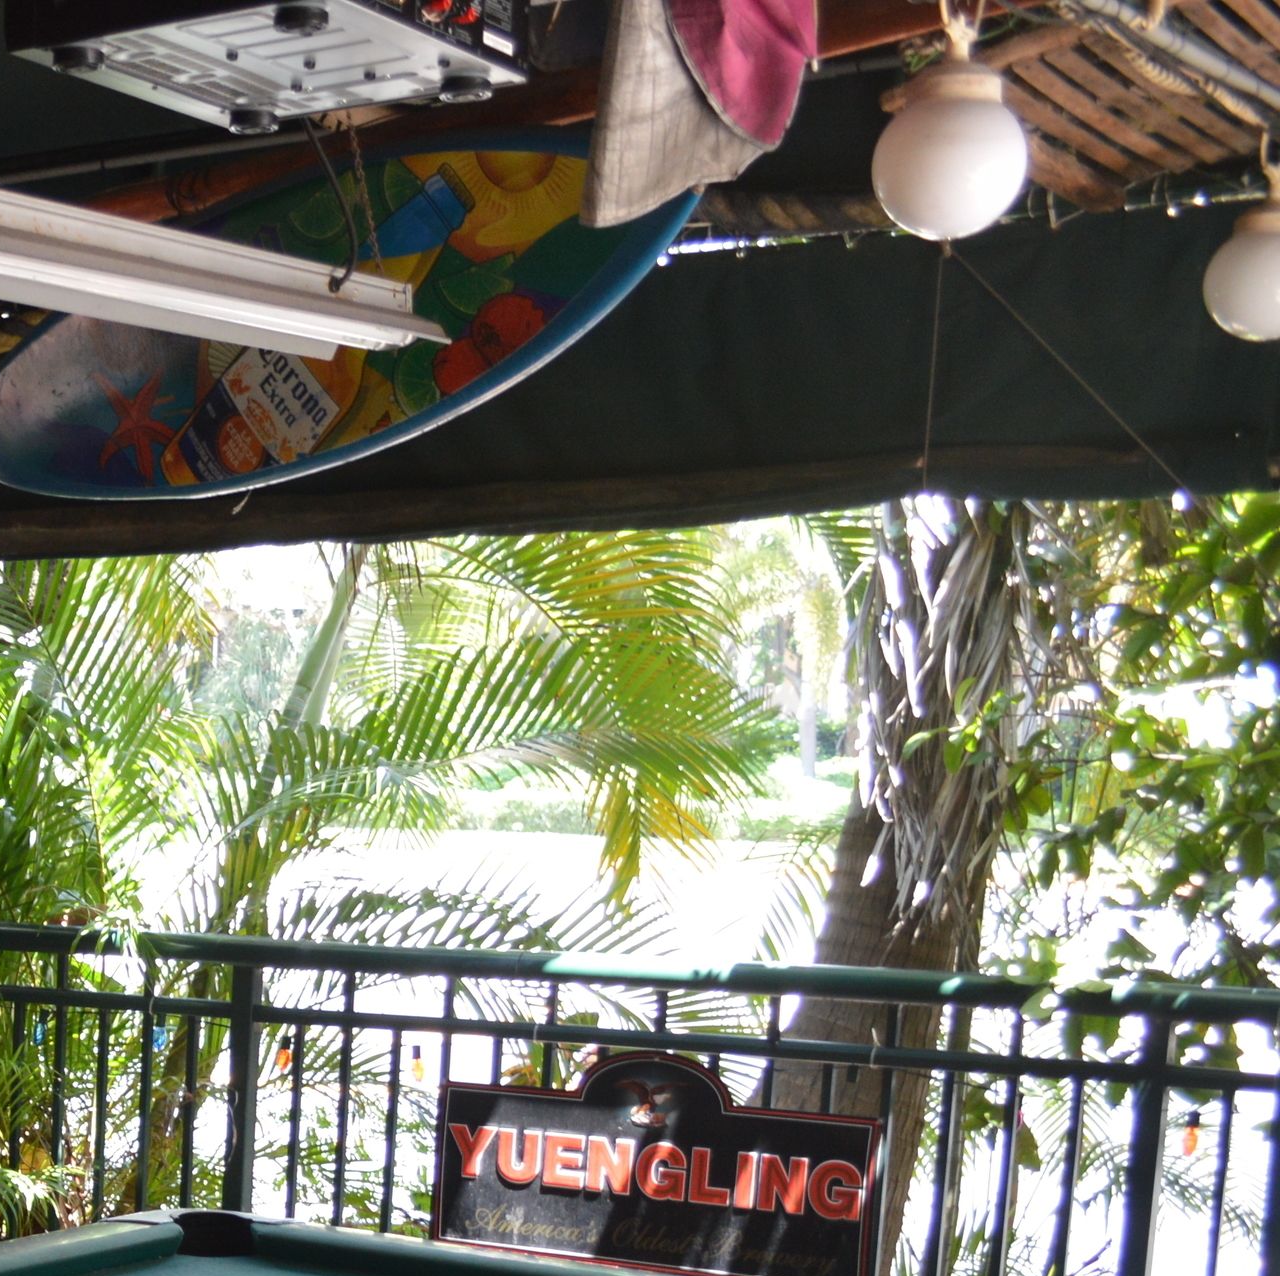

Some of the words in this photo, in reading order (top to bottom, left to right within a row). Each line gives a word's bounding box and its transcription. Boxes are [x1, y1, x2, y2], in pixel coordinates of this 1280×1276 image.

[259, 371, 297, 428] Extra
[447, 1122, 864, 1222] YUENGLING
[464, 1202, 601, 1244] America's
[612, 1218, 693, 1254] Oldest
